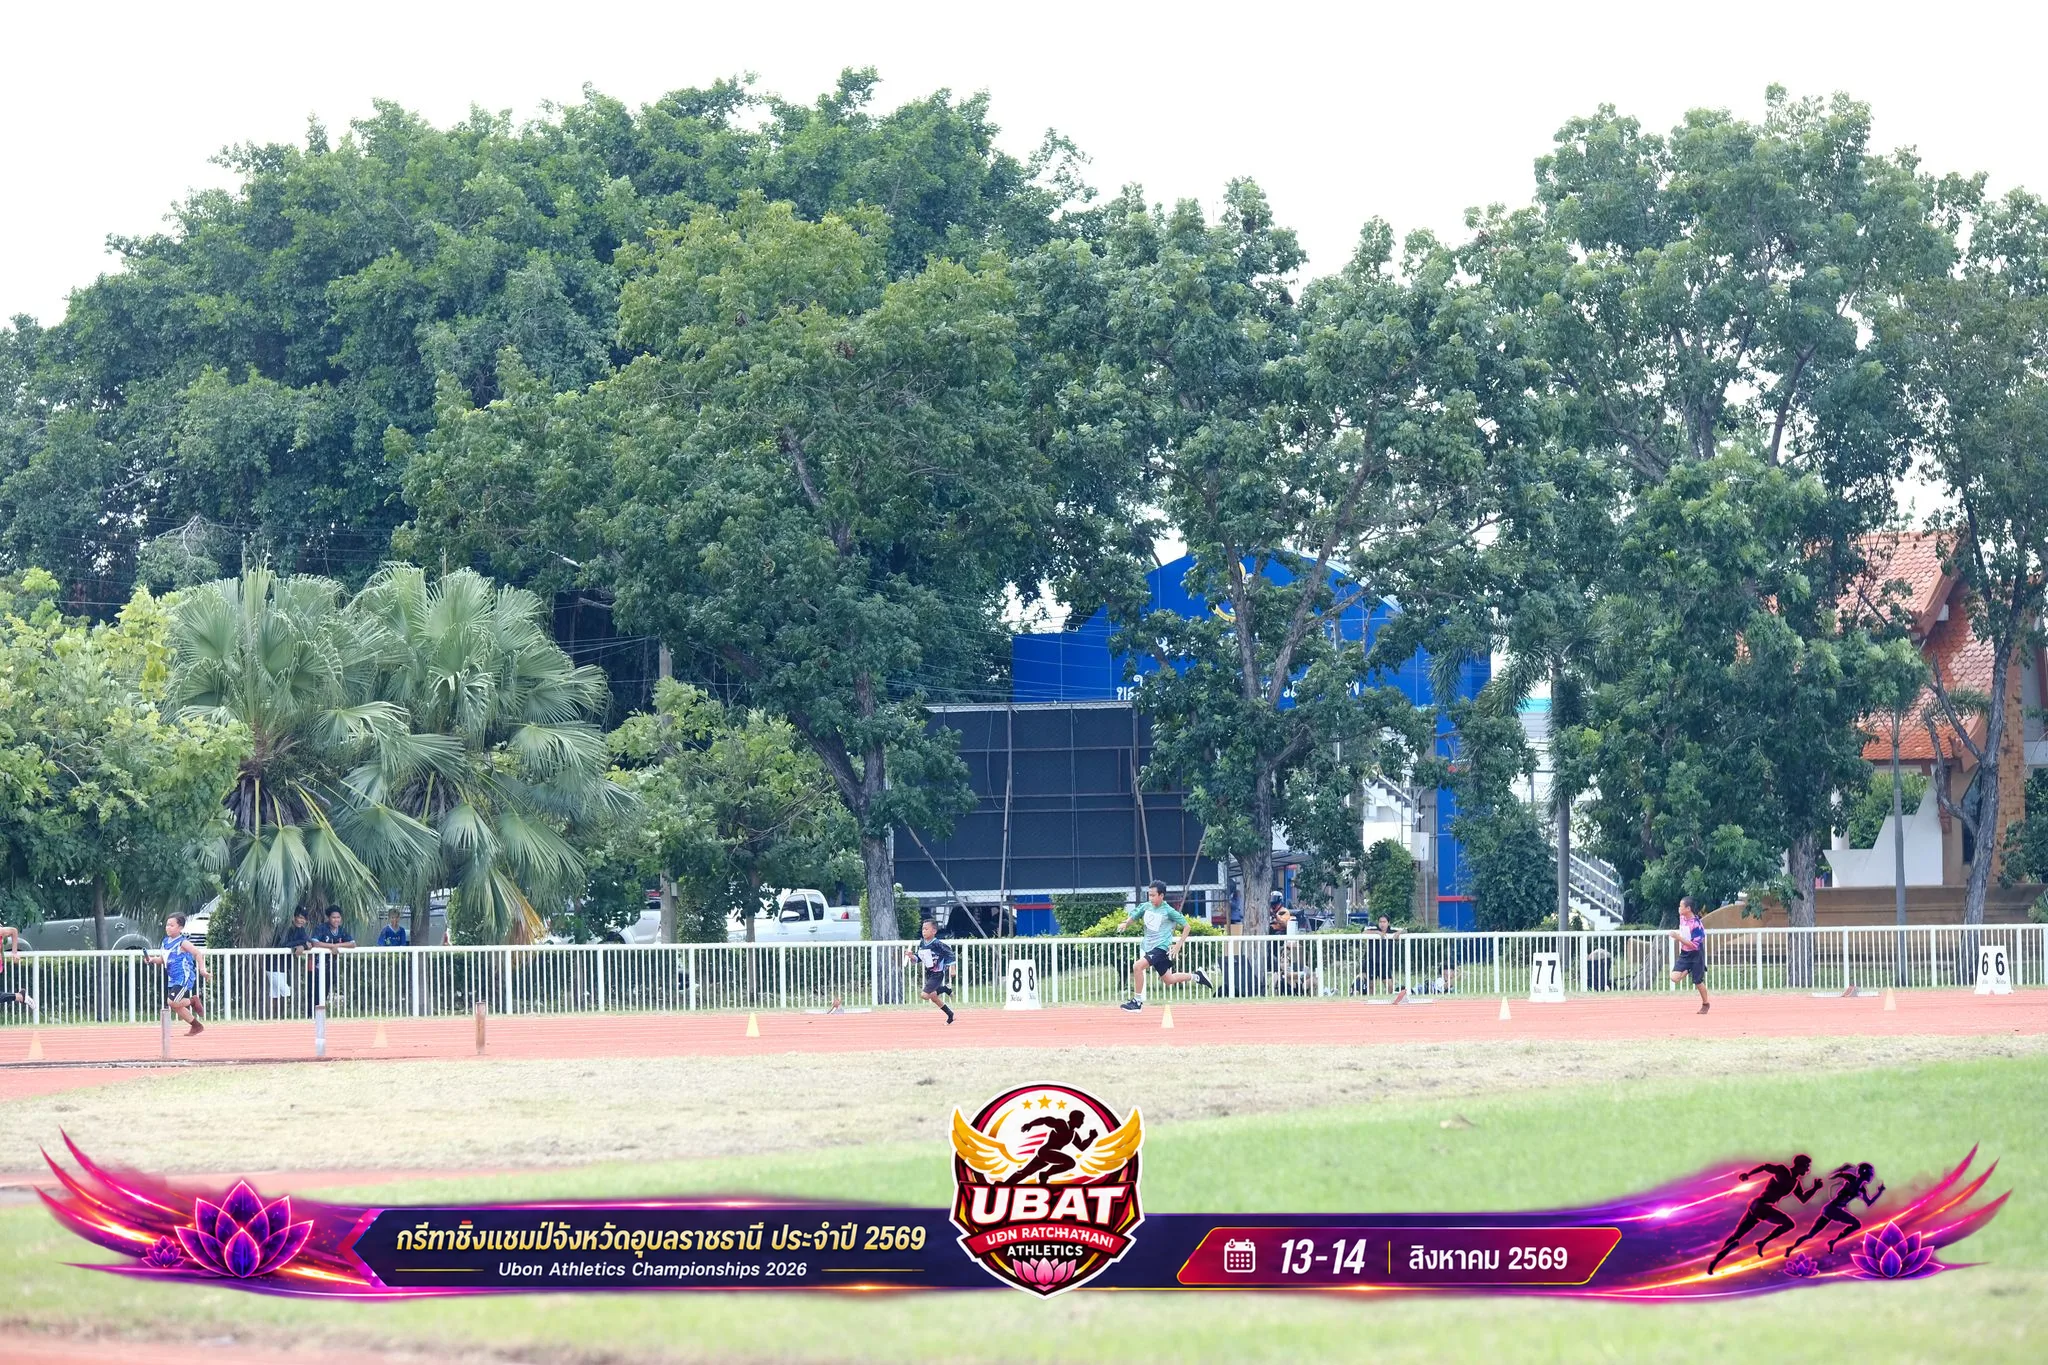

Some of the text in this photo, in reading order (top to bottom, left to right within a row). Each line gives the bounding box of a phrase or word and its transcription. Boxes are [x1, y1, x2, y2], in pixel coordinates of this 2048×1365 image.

[1536, 960, 1543, 985] 7
[1548, 960, 1557, 985] 7
[1982, 952, 1989, 976] 6
[1995, 952, 2005, 976] 6
[1012, 967, 1022, 993] 8
[1028, 966, 1035, 991] 8
